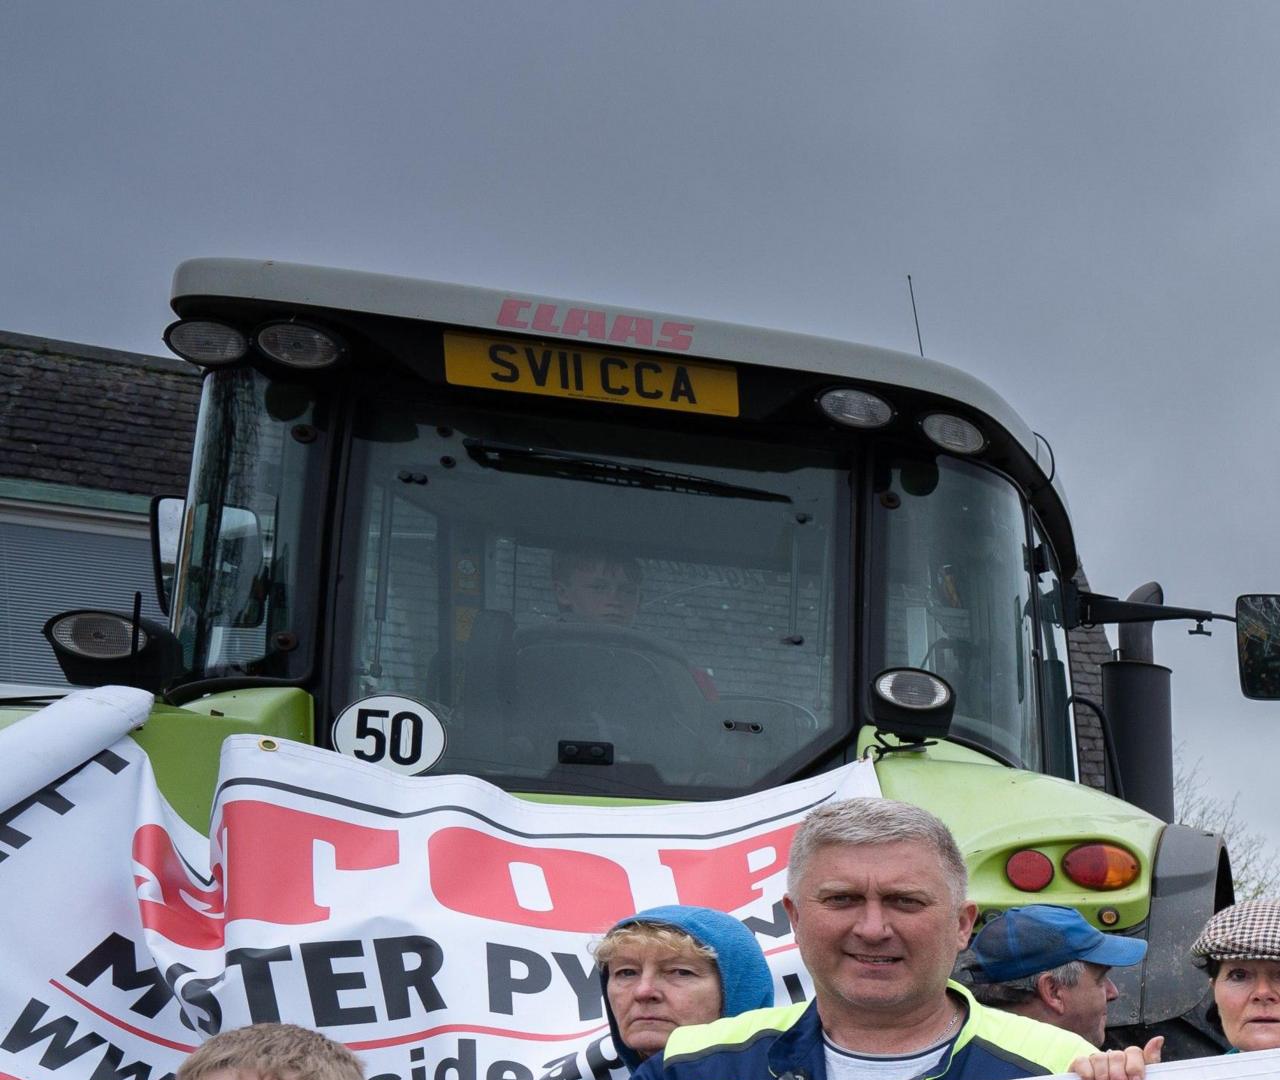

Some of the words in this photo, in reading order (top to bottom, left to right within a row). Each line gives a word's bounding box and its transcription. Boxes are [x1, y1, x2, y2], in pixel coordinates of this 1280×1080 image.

[496, 298, 695, 351] CLAAS
[488, 343, 584, 392] SV11
[600, 356, 698, 405] CCA
[353, 708, 424, 766] 50
